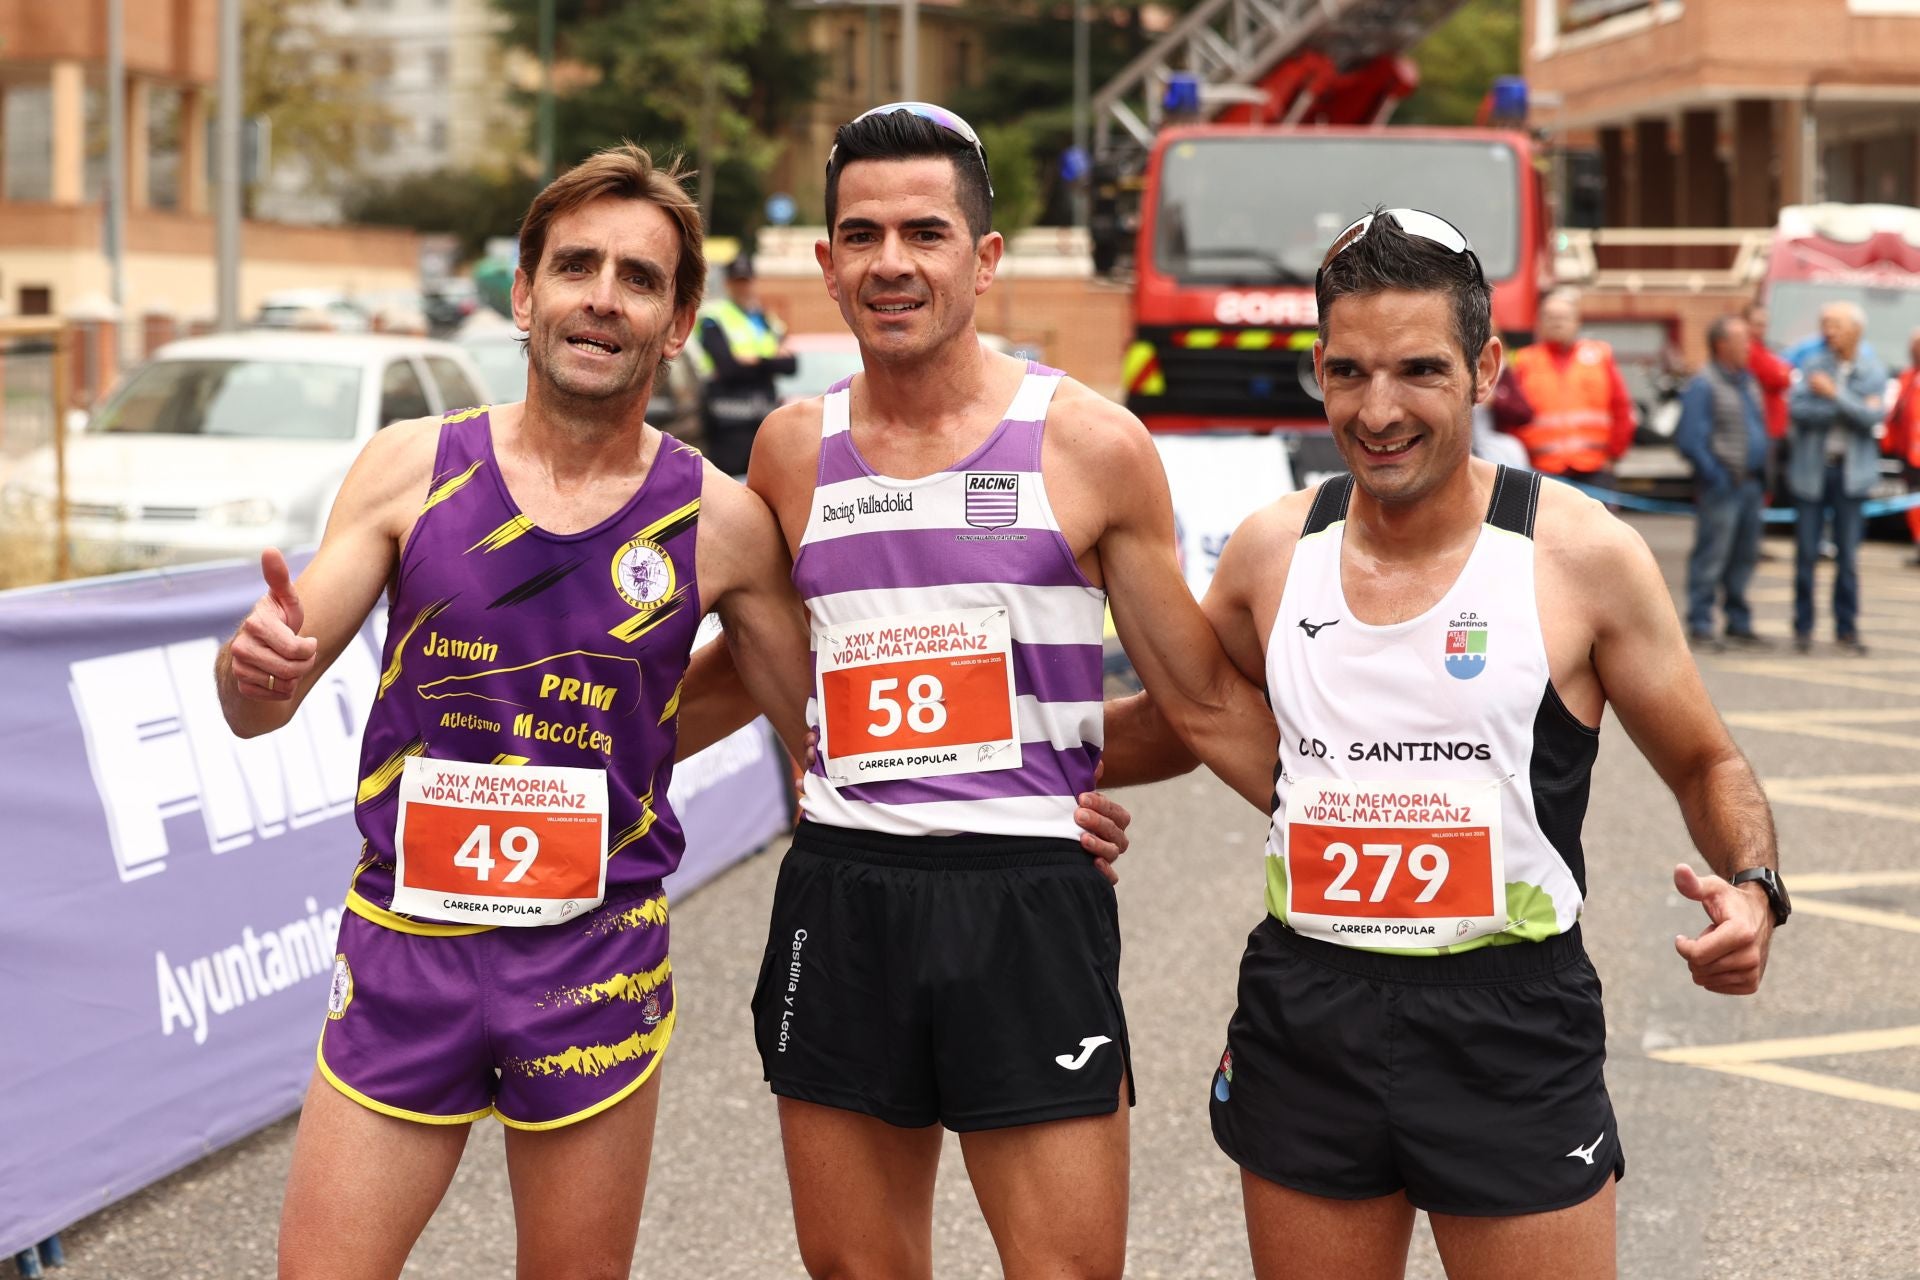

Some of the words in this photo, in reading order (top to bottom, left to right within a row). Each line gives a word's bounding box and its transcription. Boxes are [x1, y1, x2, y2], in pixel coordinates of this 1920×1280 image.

[969, 477, 1016, 490] RACING
[823, 502, 854, 524] Racing
[857, 492, 913, 515] Valladolid
[628, 539, 668, 559] ATLETISMO
[617, 586, 665, 608] MACOTERA
[845, 632, 875, 648] XXIX
[879, 622, 968, 644] MEMORIAL
[1449, 620, 1488, 628] Santinos
[423, 632, 498, 662] Jamón
[833, 634, 988, 665] VIDAL-MATARRANZ
[540, 673, 617, 711] PRIM
[867, 674, 947, 737] 58
[440, 712, 500, 733] Atletismo
[513, 713, 612, 755] Macotera
[858, 758, 904, 771] CARRERA
[907, 753, 957, 766] POPULAR
[1299, 738, 1335, 759] C.D.
[1348, 742, 1491, 762] SANTINOS
[436, 773, 470, 788] XXIX
[475, 776, 568, 793] MEMORIAL
[422, 785, 586, 809] VIDAL-MATARRANZ
[1318, 791, 1351, 807] XXIX
[1356, 793, 1452, 808] MEMORIAL
[1304, 805, 1471, 822] VIDAL-MATARRANZ
[453, 824, 540, 883] 49
[1323, 842, 1450, 903] 279
[443, 899, 489, 912] CARRERA
[492, 903, 542, 915] POPULAR
[1332, 923, 1381, 934] CARRERA
[1384, 924, 1435, 934] POPULAR
[787, 928, 808, 993] Castilla
[784, 994, 794, 1007] y
[777, 1010, 794, 1053] León
